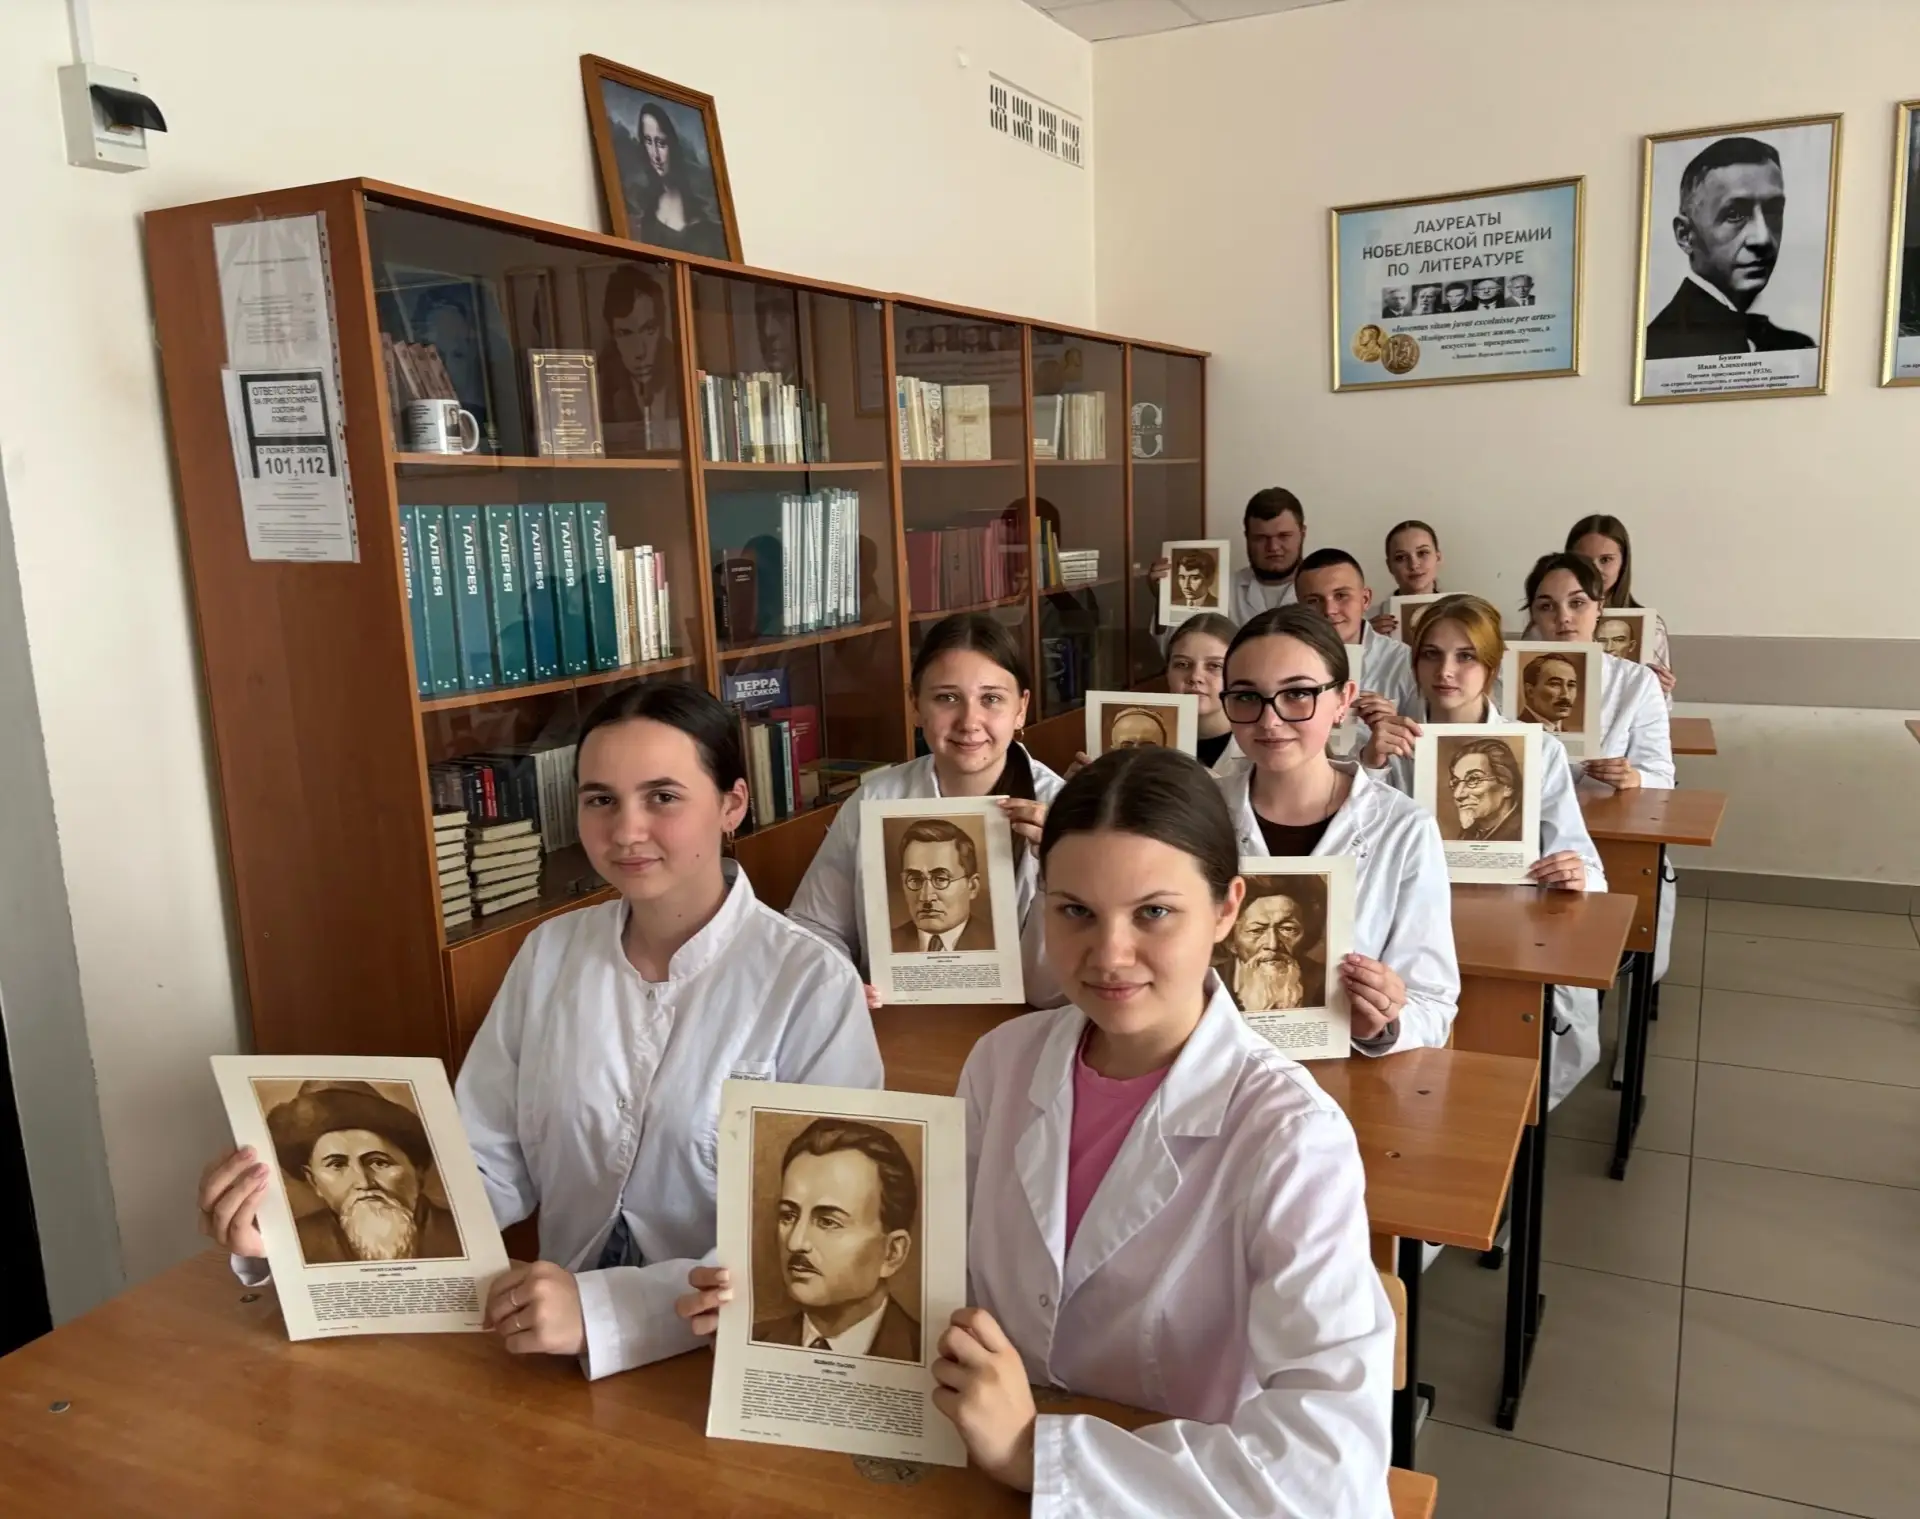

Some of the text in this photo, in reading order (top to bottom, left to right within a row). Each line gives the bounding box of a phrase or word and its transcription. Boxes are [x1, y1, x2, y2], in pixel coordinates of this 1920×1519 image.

[1362, 226, 1552, 260] НОБЕЛЕВСКОЙ ПРЕМИИ
[1413, 211, 1502, 235] ЛАУРЕАТЫ
[1387, 250, 1525, 277] ПО ЛИТЕРАТУРЕ
[1515, 315, 1530, 325] per
[427, 525, 444, 596] ГАЛЕРЕЯ
[462, 525, 478, 595] ГАЛЕРЕЯ
[498, 524, 513, 592] ГАЛЕРЕЯ
[530, 523, 545, 590] ГАЛЕРЕЯ
[560, 521, 575, 587] ГАЛЕРЕЯ
[592, 520, 606, 584] ГАЛЕРЕЯ
[734, 677, 780, 692] ТЕРРА
